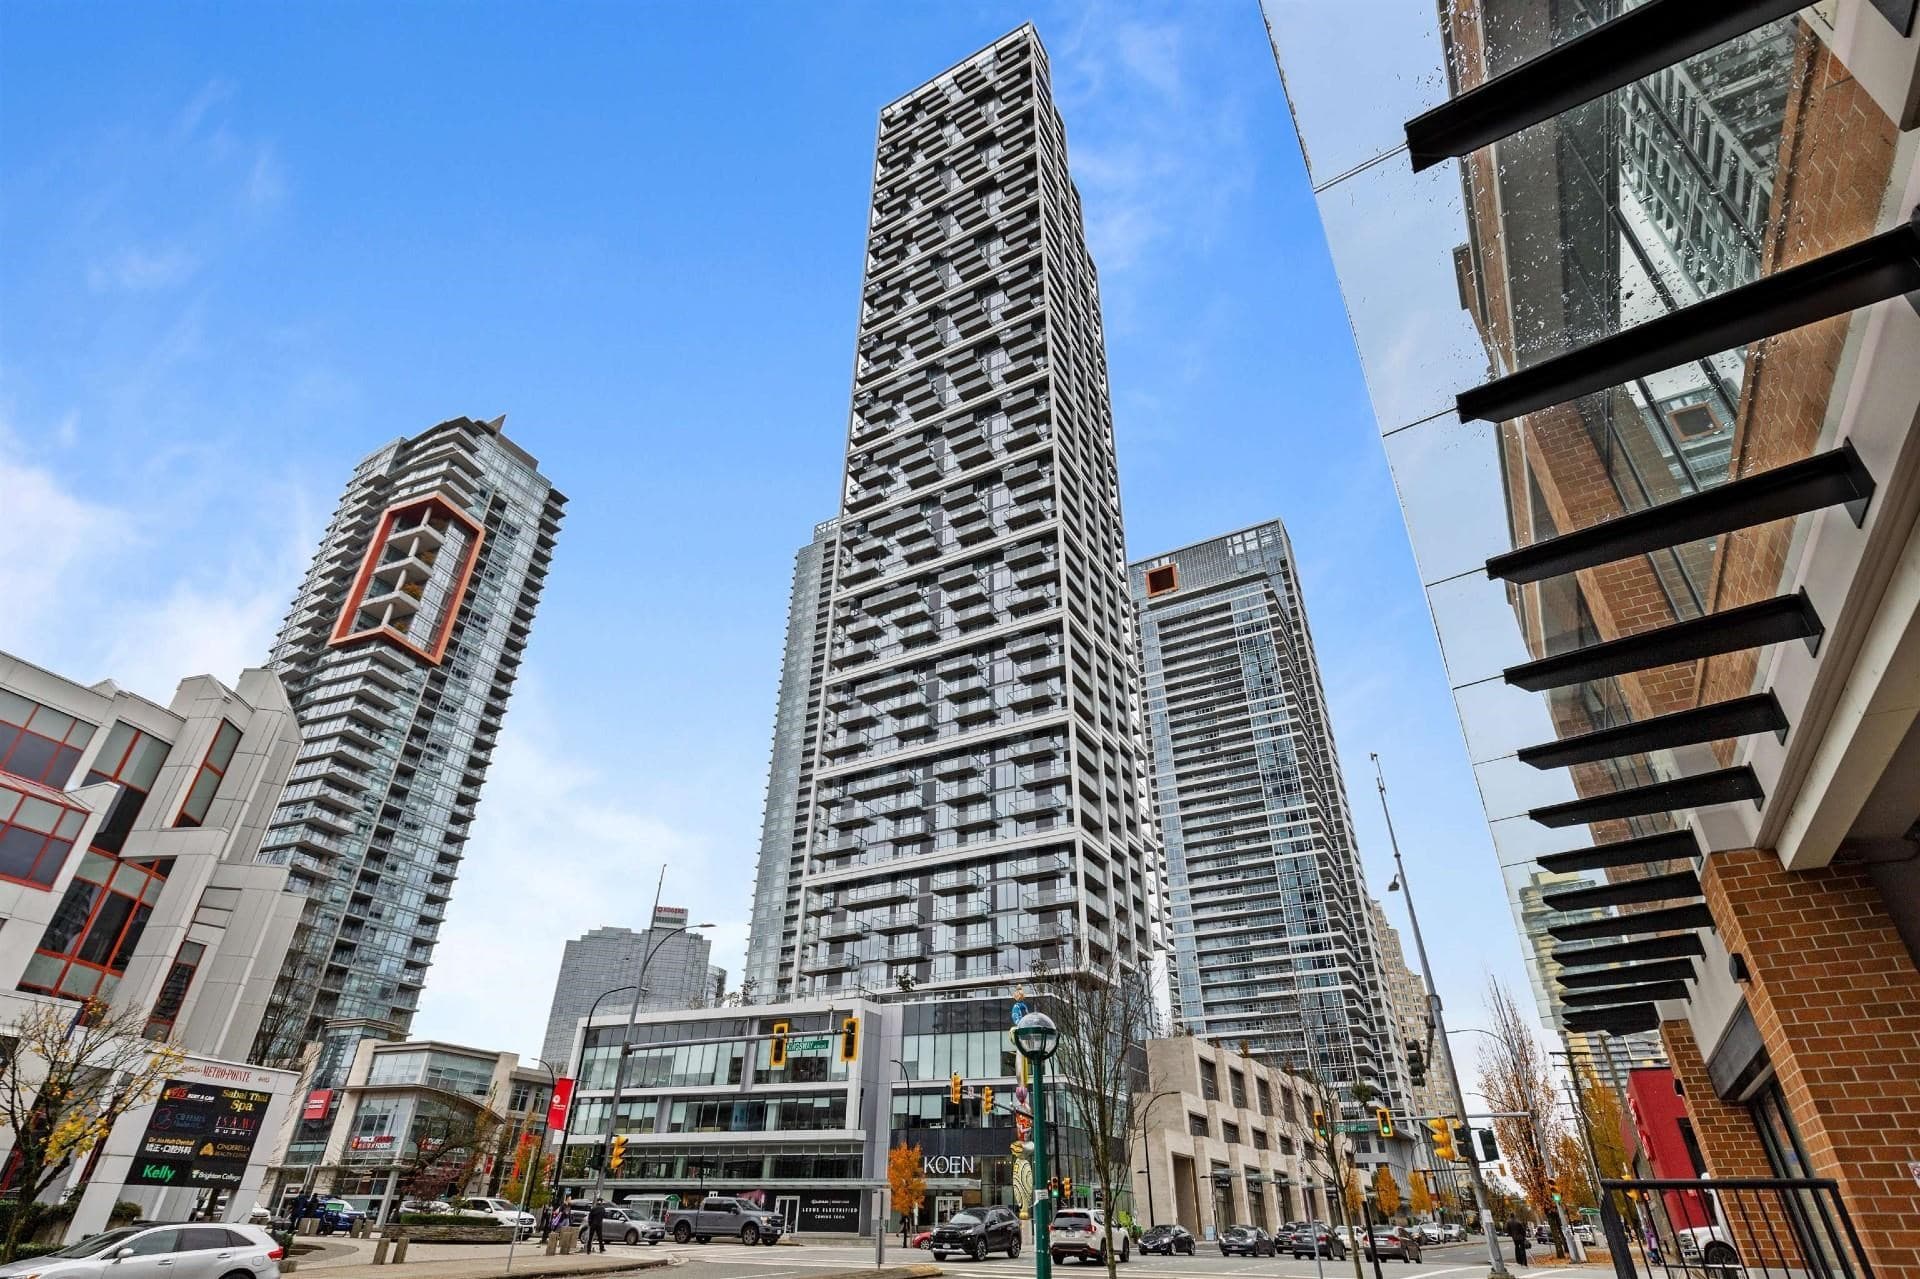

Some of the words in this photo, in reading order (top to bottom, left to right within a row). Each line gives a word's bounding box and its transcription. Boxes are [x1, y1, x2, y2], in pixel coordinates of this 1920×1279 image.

[222, 1089, 247, 1099] Sabai
[249, 1092, 268, 1102] Thai
[230, 1100, 253, 1113] Spa
[924, 1155, 974, 1174] KOEN
[142, 1164, 176, 1183] Kelly
[198, 1170, 222, 1181] Brighton
[222, 1172, 241, 1182] College
